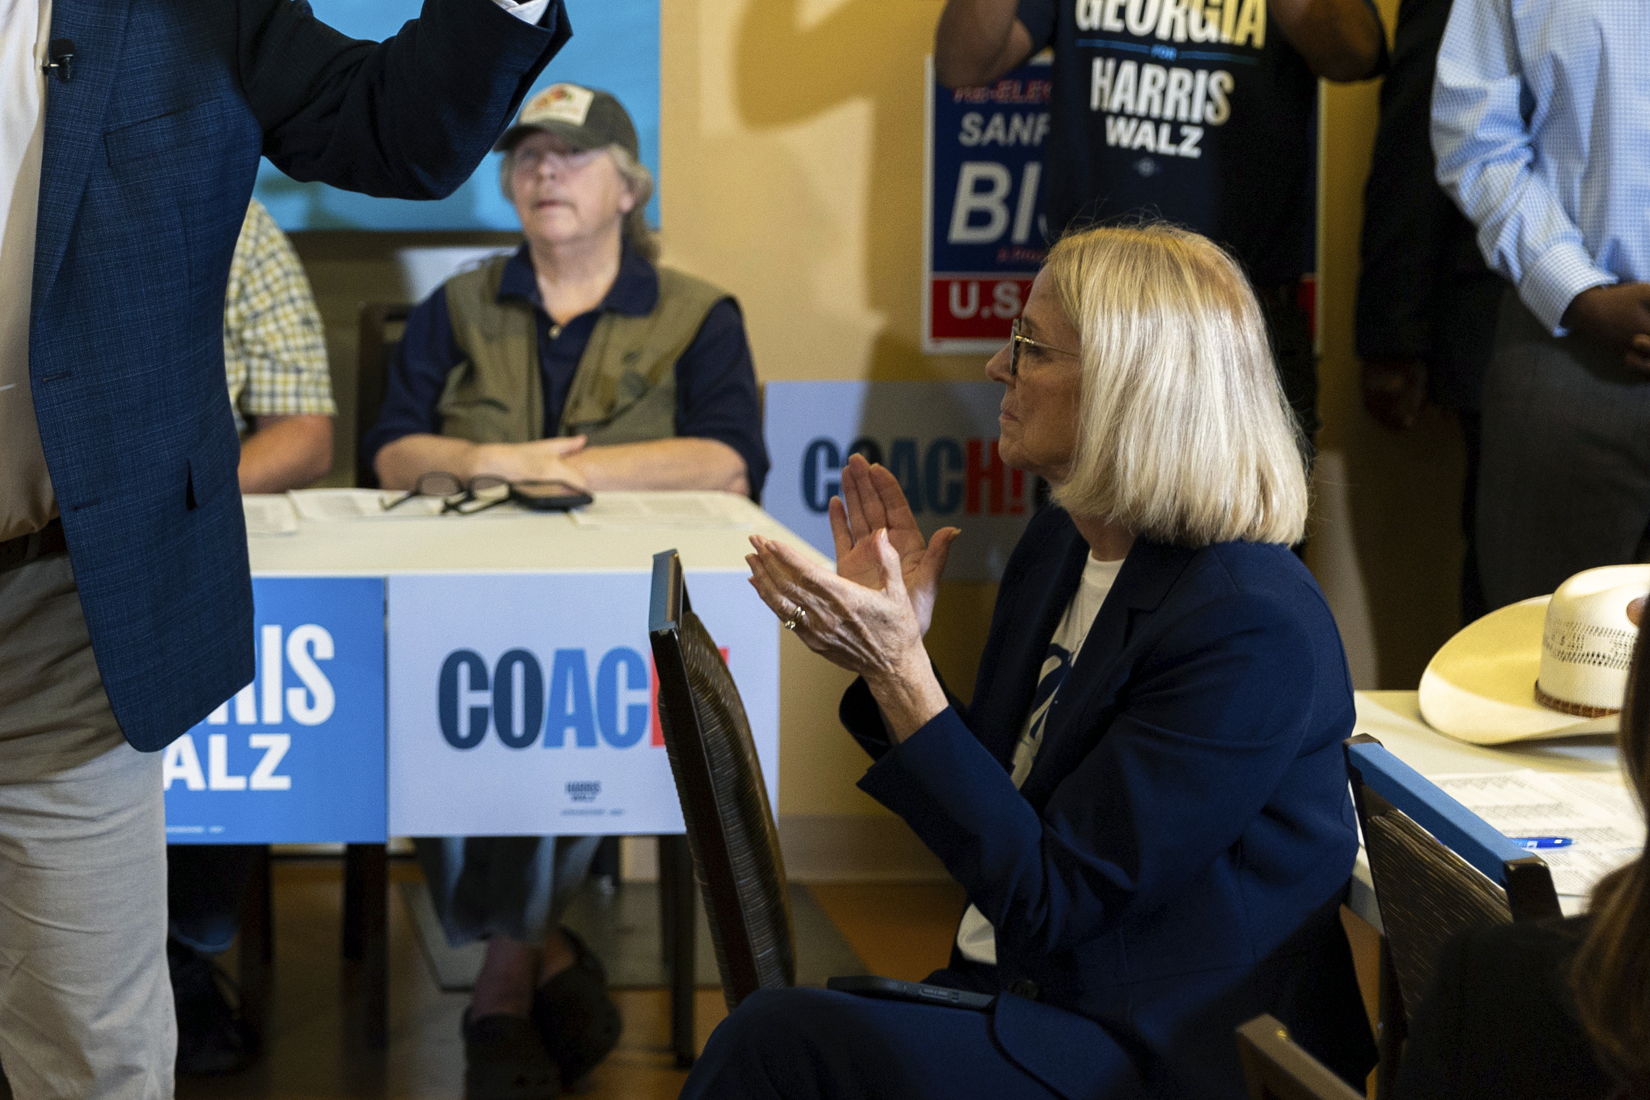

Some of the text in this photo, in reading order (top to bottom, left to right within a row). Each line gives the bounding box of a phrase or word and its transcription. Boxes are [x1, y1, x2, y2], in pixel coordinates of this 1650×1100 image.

[1090, 55, 1235, 127] HARRIS
[1104, 115, 1205, 159] WALZ
[802, 437, 1026, 515] CACH!
